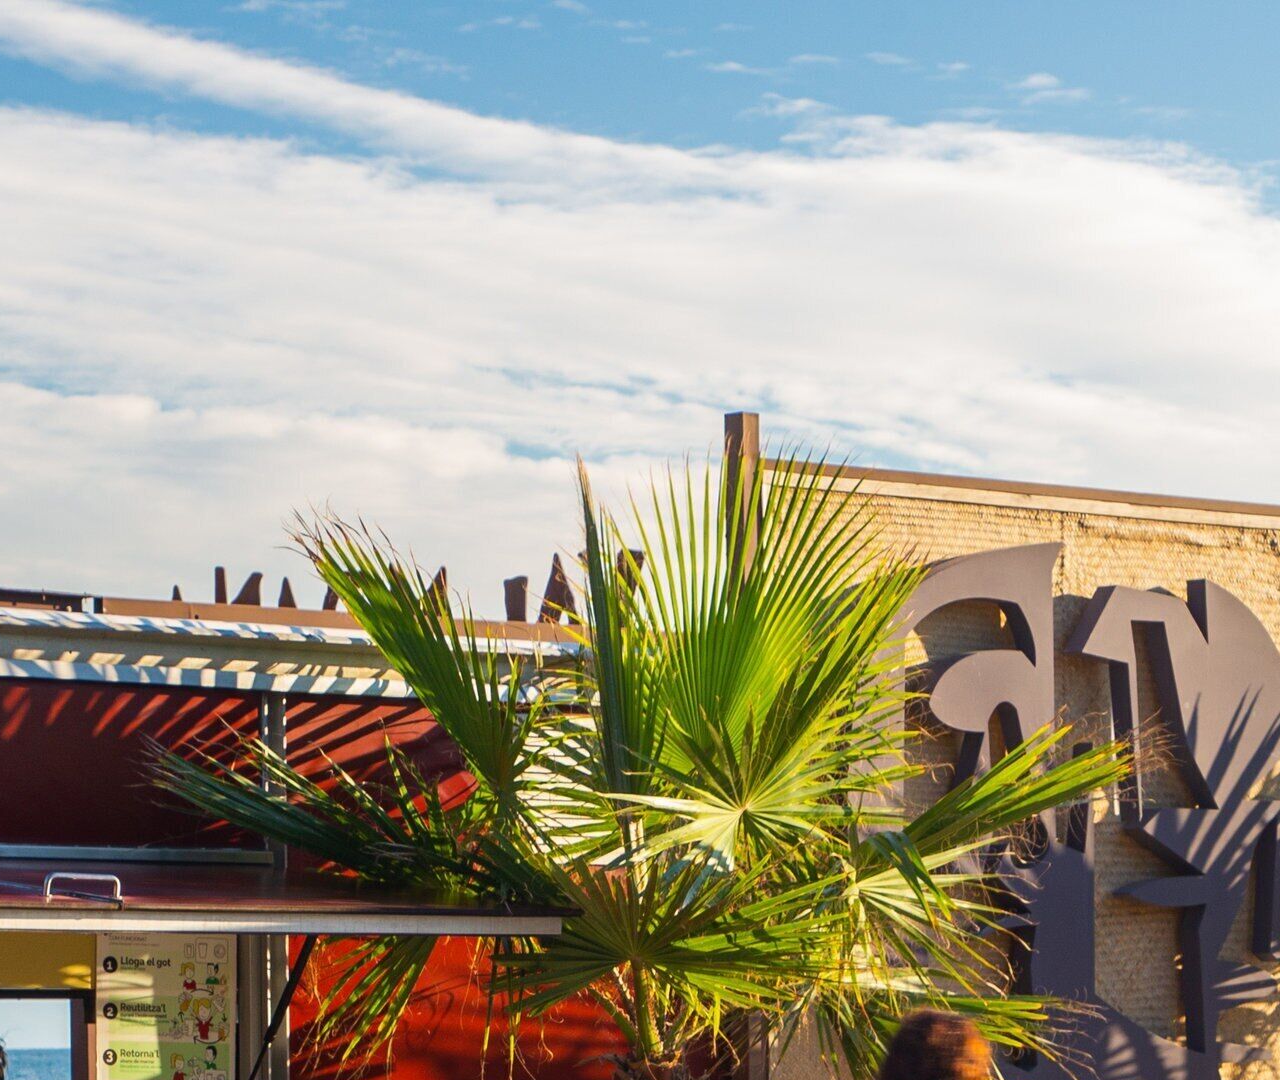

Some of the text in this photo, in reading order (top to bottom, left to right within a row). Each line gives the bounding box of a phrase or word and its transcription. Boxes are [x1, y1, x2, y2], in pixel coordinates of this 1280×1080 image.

[120, 956, 145, 968] Lloga
[147, 957, 156, 967] el
[157, 958, 171, 969] got
[120, 1003, 166, 1014] Reutilitza'l
